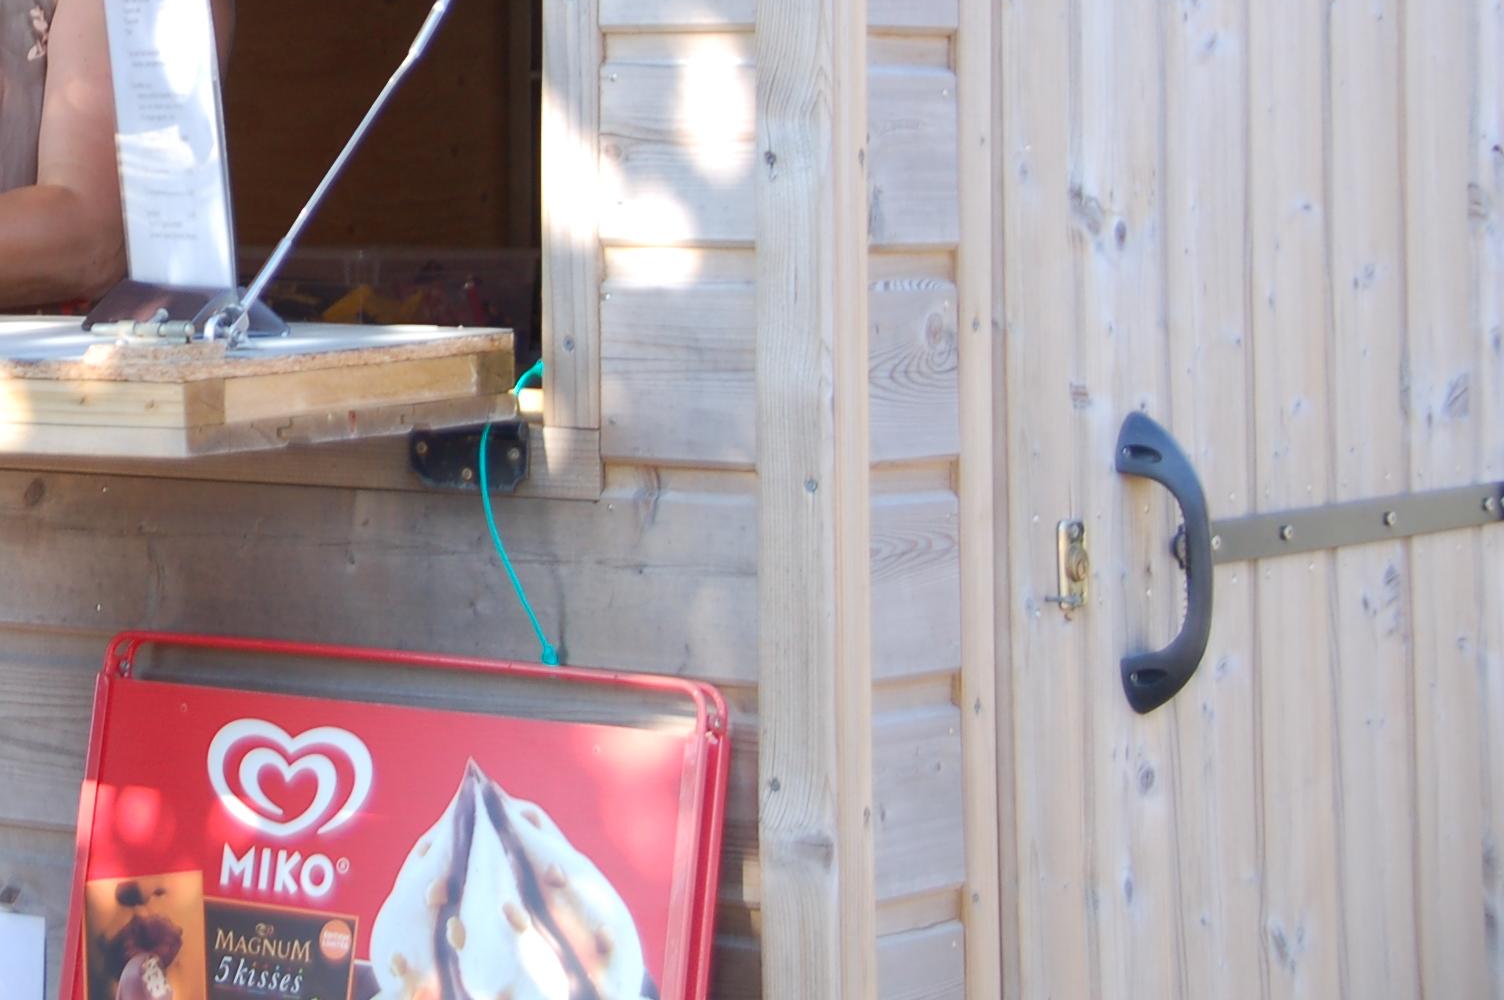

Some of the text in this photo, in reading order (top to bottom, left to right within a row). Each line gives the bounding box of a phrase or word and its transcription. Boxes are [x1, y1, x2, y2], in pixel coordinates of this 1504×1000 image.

[219, 842, 334, 897] MIKO
[214, 927, 312, 963] MAGNUM
[214, 956, 304, 993] 5 kisses
